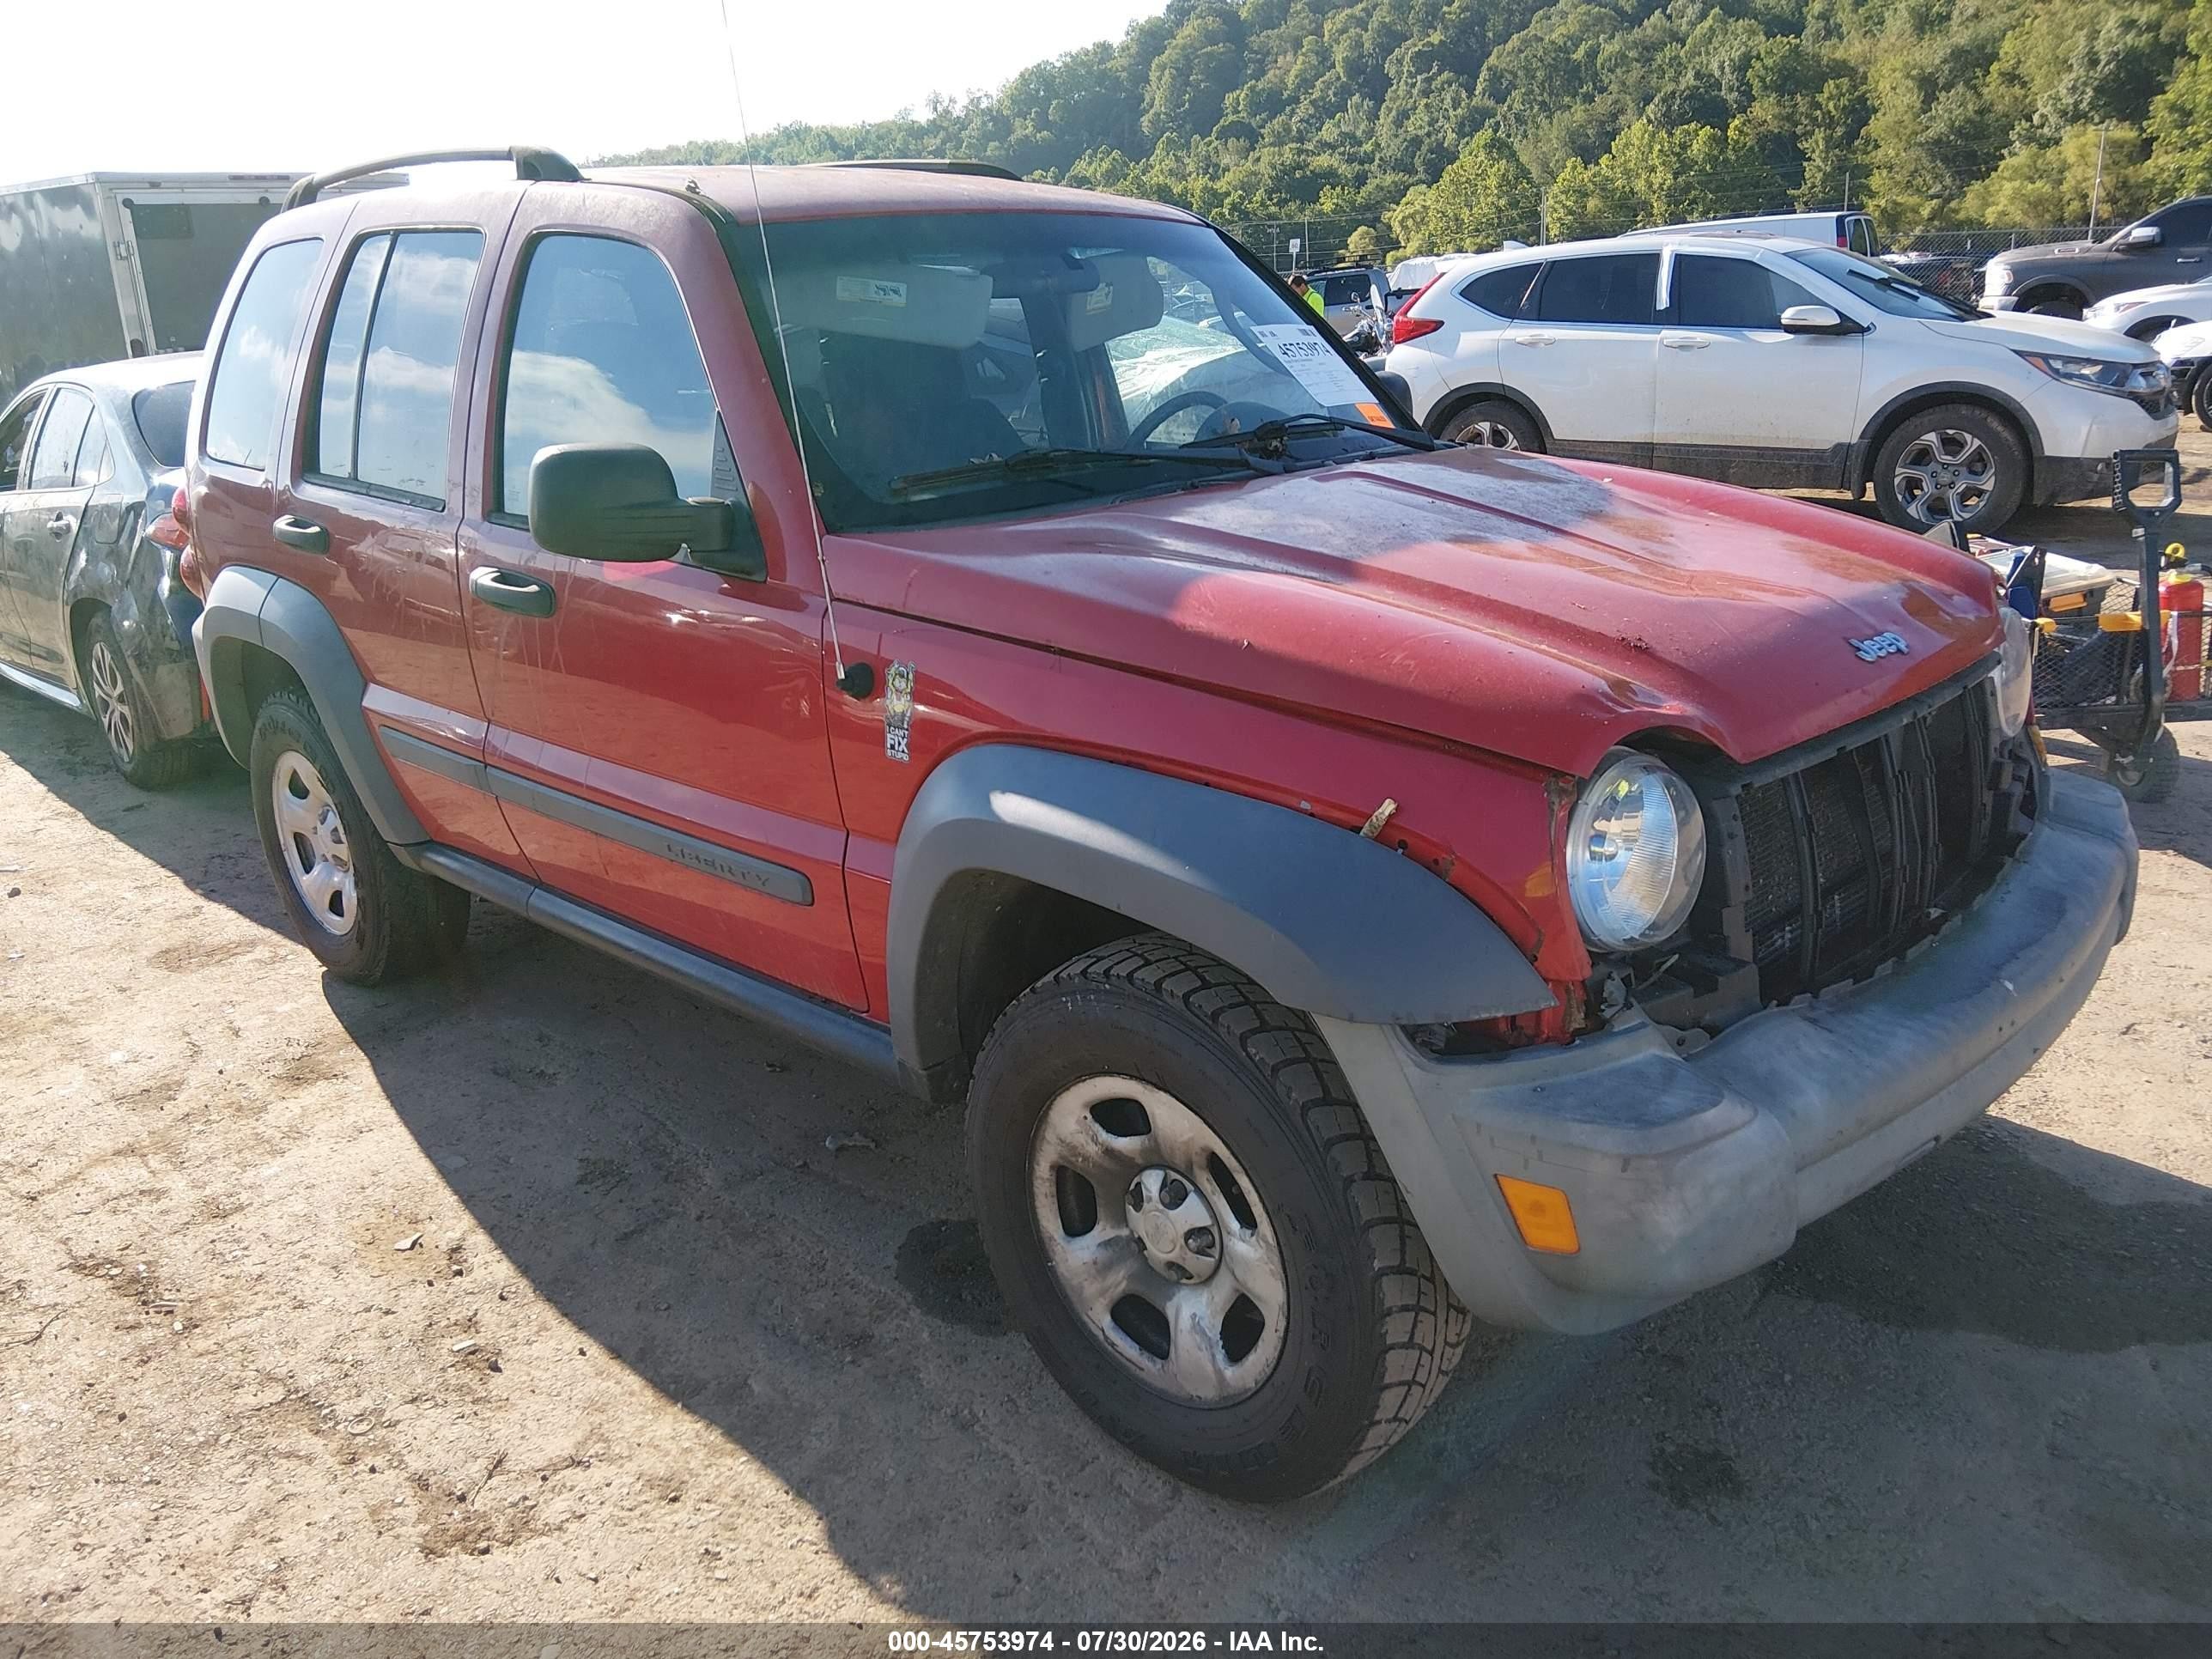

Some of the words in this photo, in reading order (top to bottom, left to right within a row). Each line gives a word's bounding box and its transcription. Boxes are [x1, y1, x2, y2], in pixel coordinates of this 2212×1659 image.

[1278, 342, 1334, 358] 45753974
[1848, 632, 1910, 662] Jeep
[887, 732, 909, 754] FIX
[666, 843, 770, 887] LIBERTY
